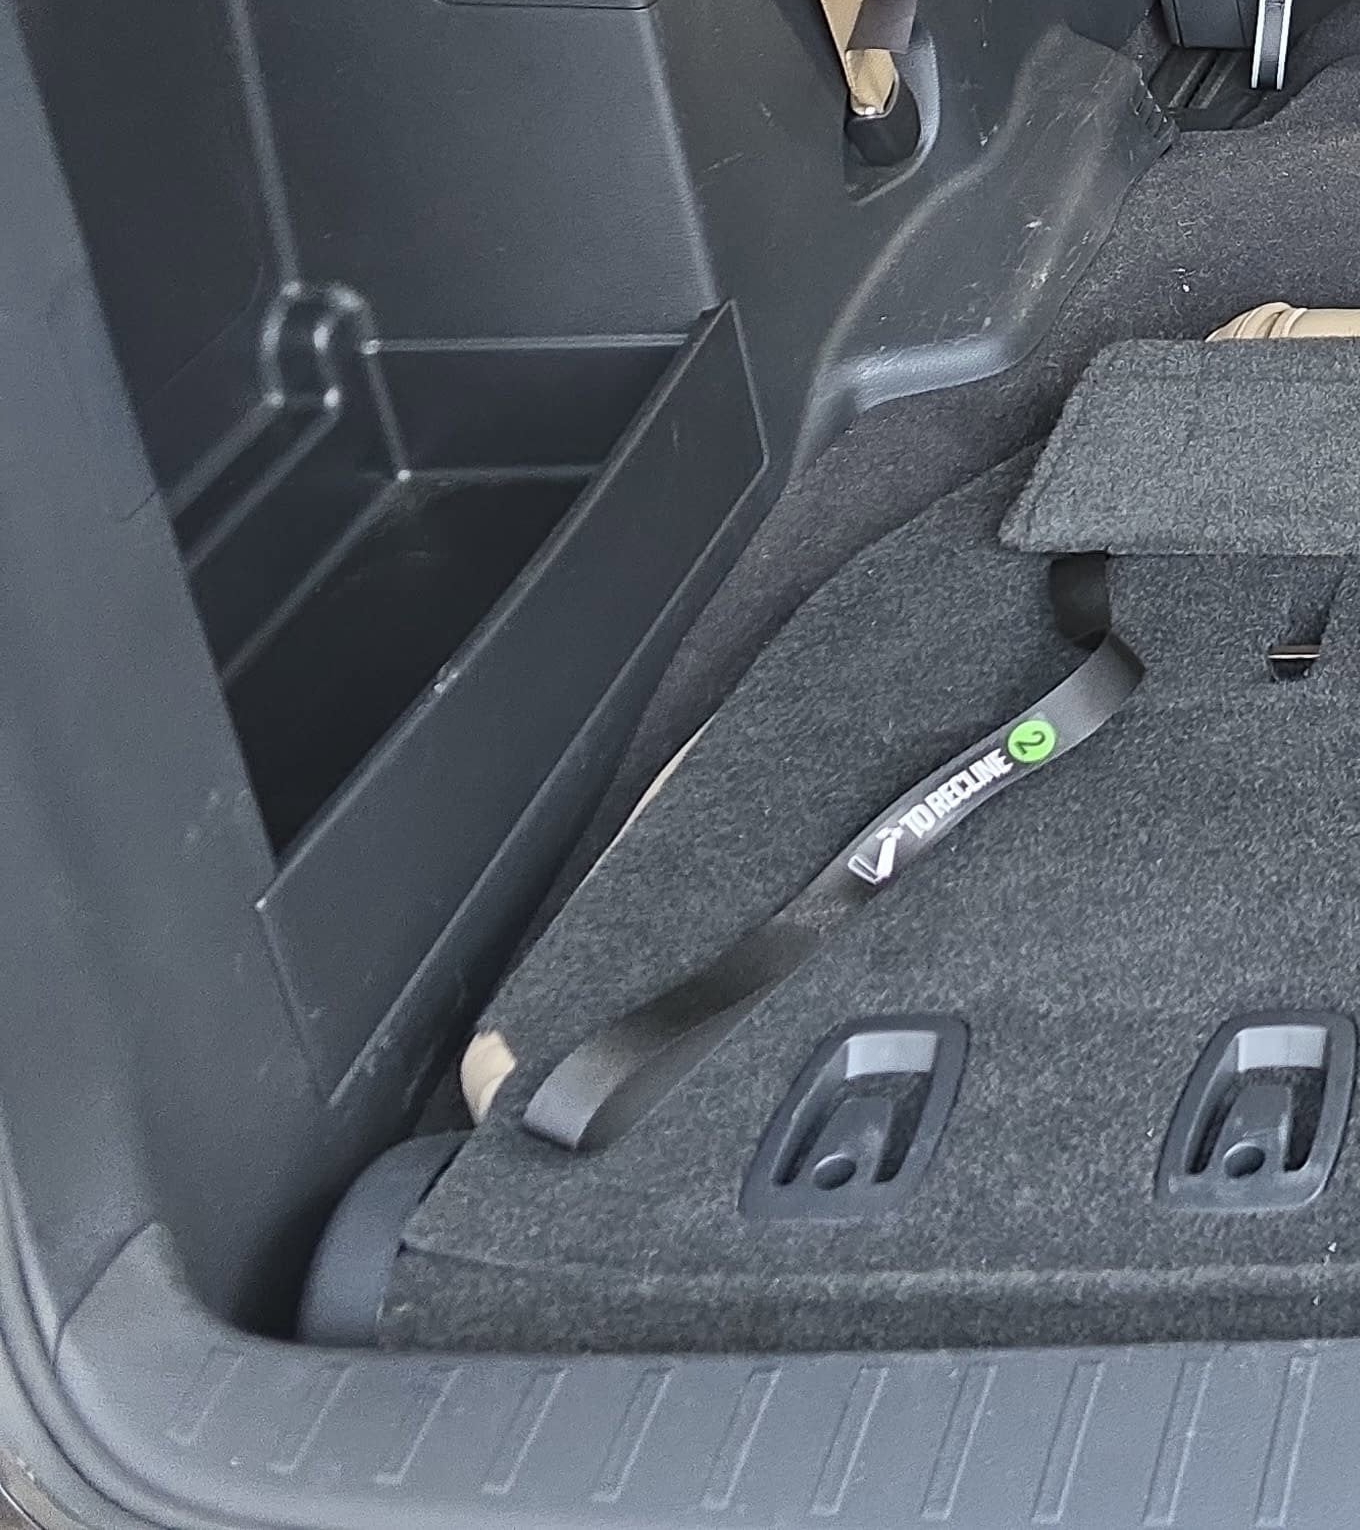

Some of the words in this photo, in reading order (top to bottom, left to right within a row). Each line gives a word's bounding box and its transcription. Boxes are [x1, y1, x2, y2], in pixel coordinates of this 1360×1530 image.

[1013, 729, 1046, 756] 2
[898, 803, 937, 839] TO
[924, 747, 1014, 819] RECLINE
